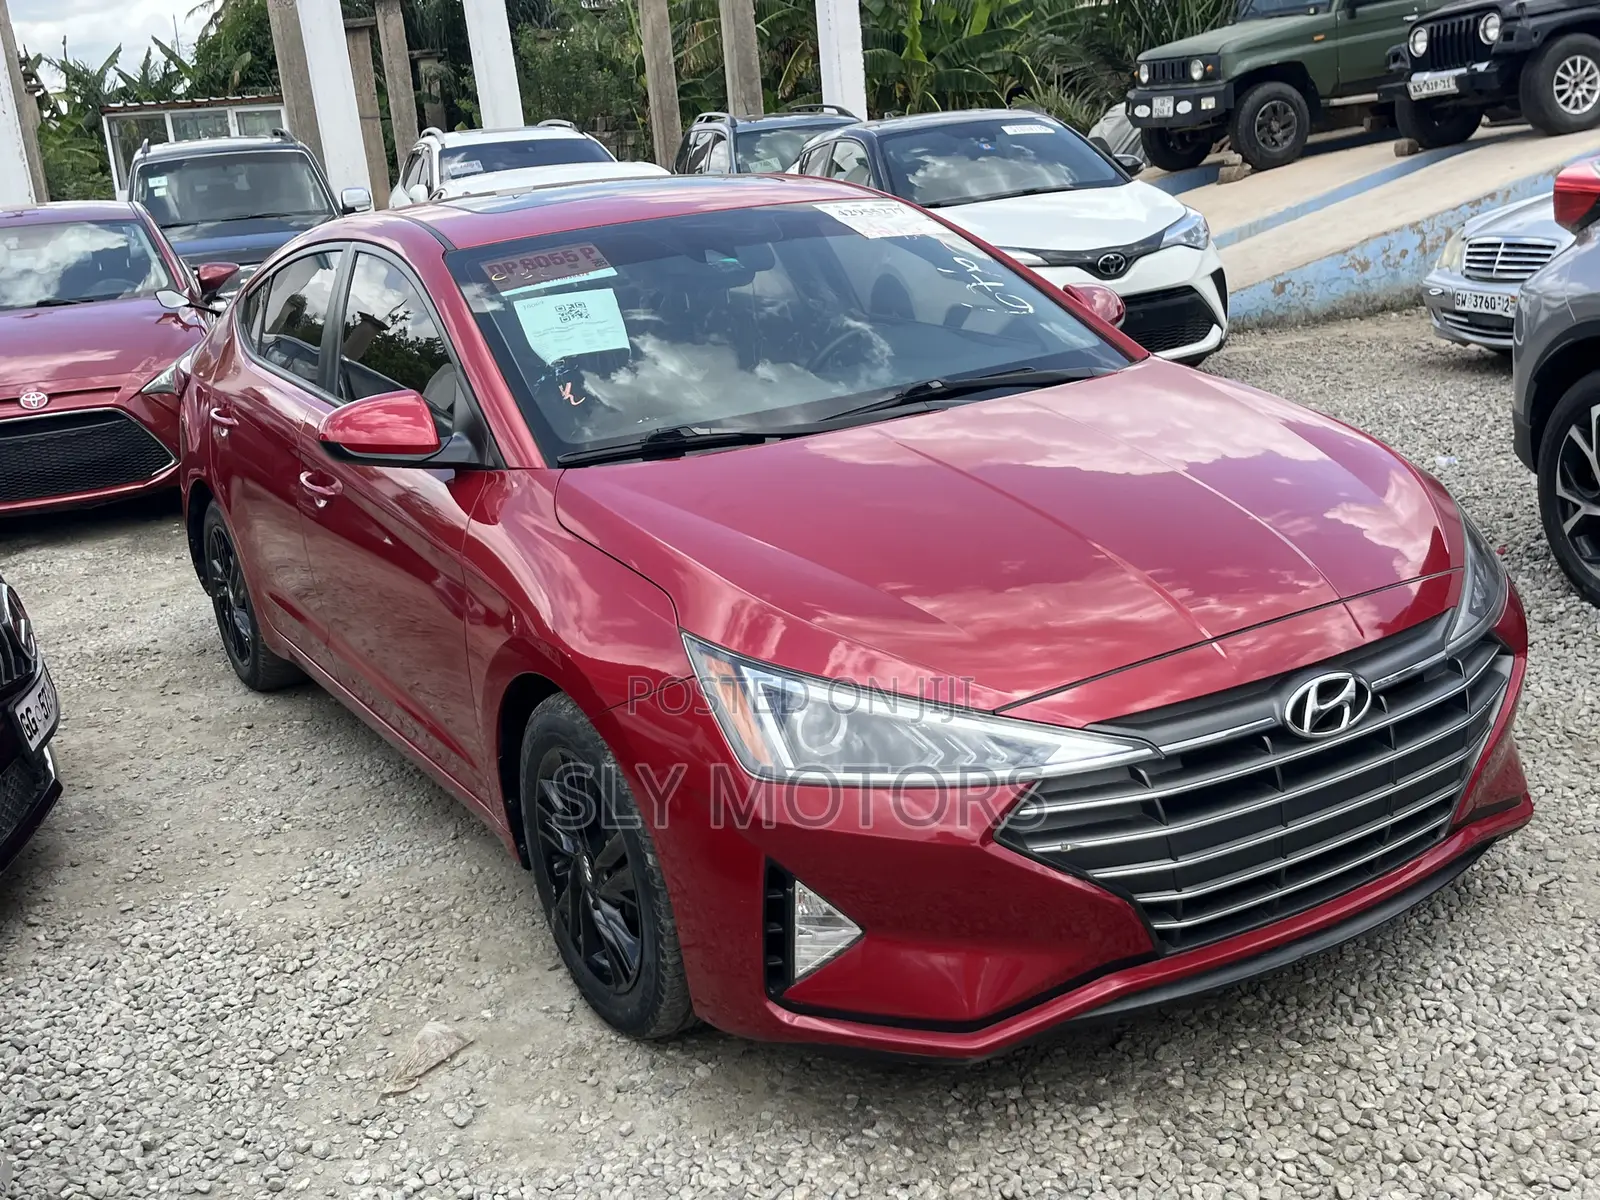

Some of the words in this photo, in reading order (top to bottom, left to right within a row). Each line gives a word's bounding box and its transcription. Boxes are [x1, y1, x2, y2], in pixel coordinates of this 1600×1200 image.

[520, 249, 580, 271] 8055
[580, 246, 596, 260] P
[1456, 292, 1467, 307] GW
[20, 706, 39, 741] GG
